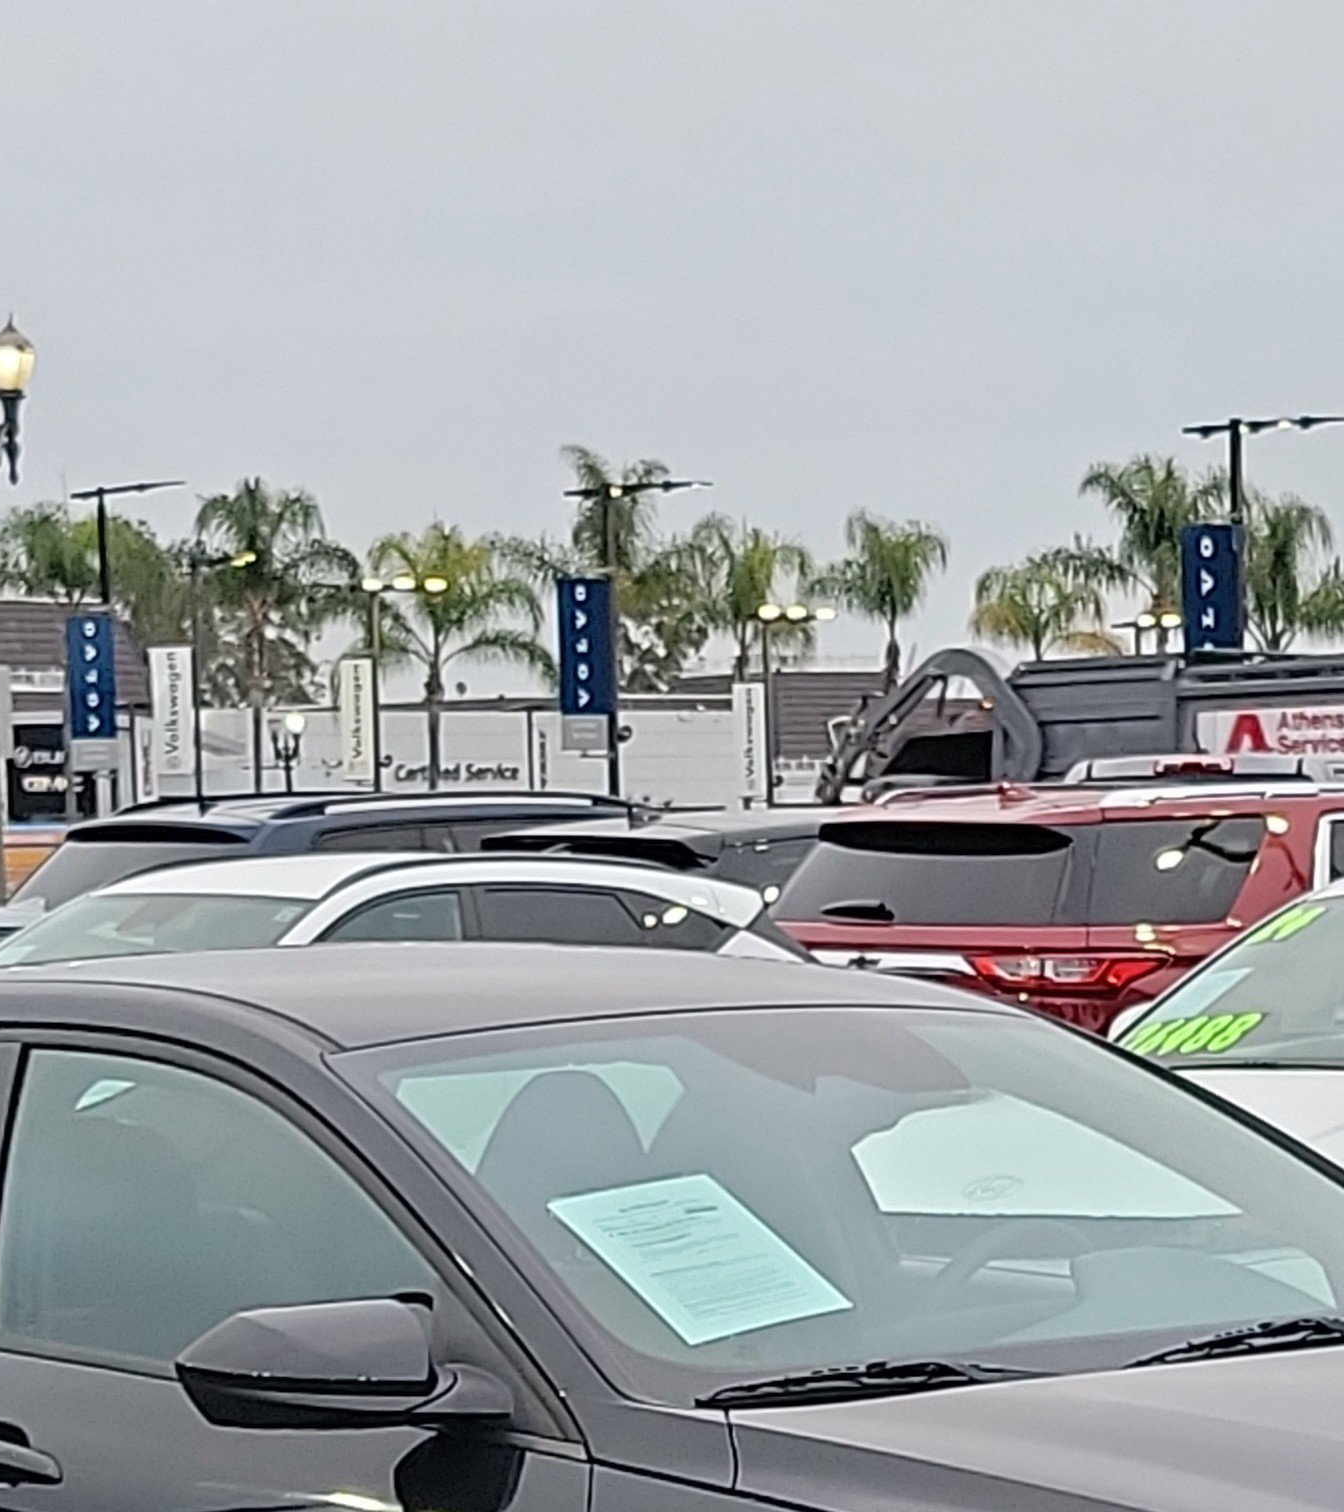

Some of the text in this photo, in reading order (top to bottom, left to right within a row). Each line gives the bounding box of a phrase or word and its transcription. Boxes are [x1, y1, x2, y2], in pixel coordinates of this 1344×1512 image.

[83, 620, 100, 733] VOLVO
[574, 584, 590, 708] VOLVO
[164, 651, 182, 755] Volkswagen
[465, 763, 520, 782] Service
